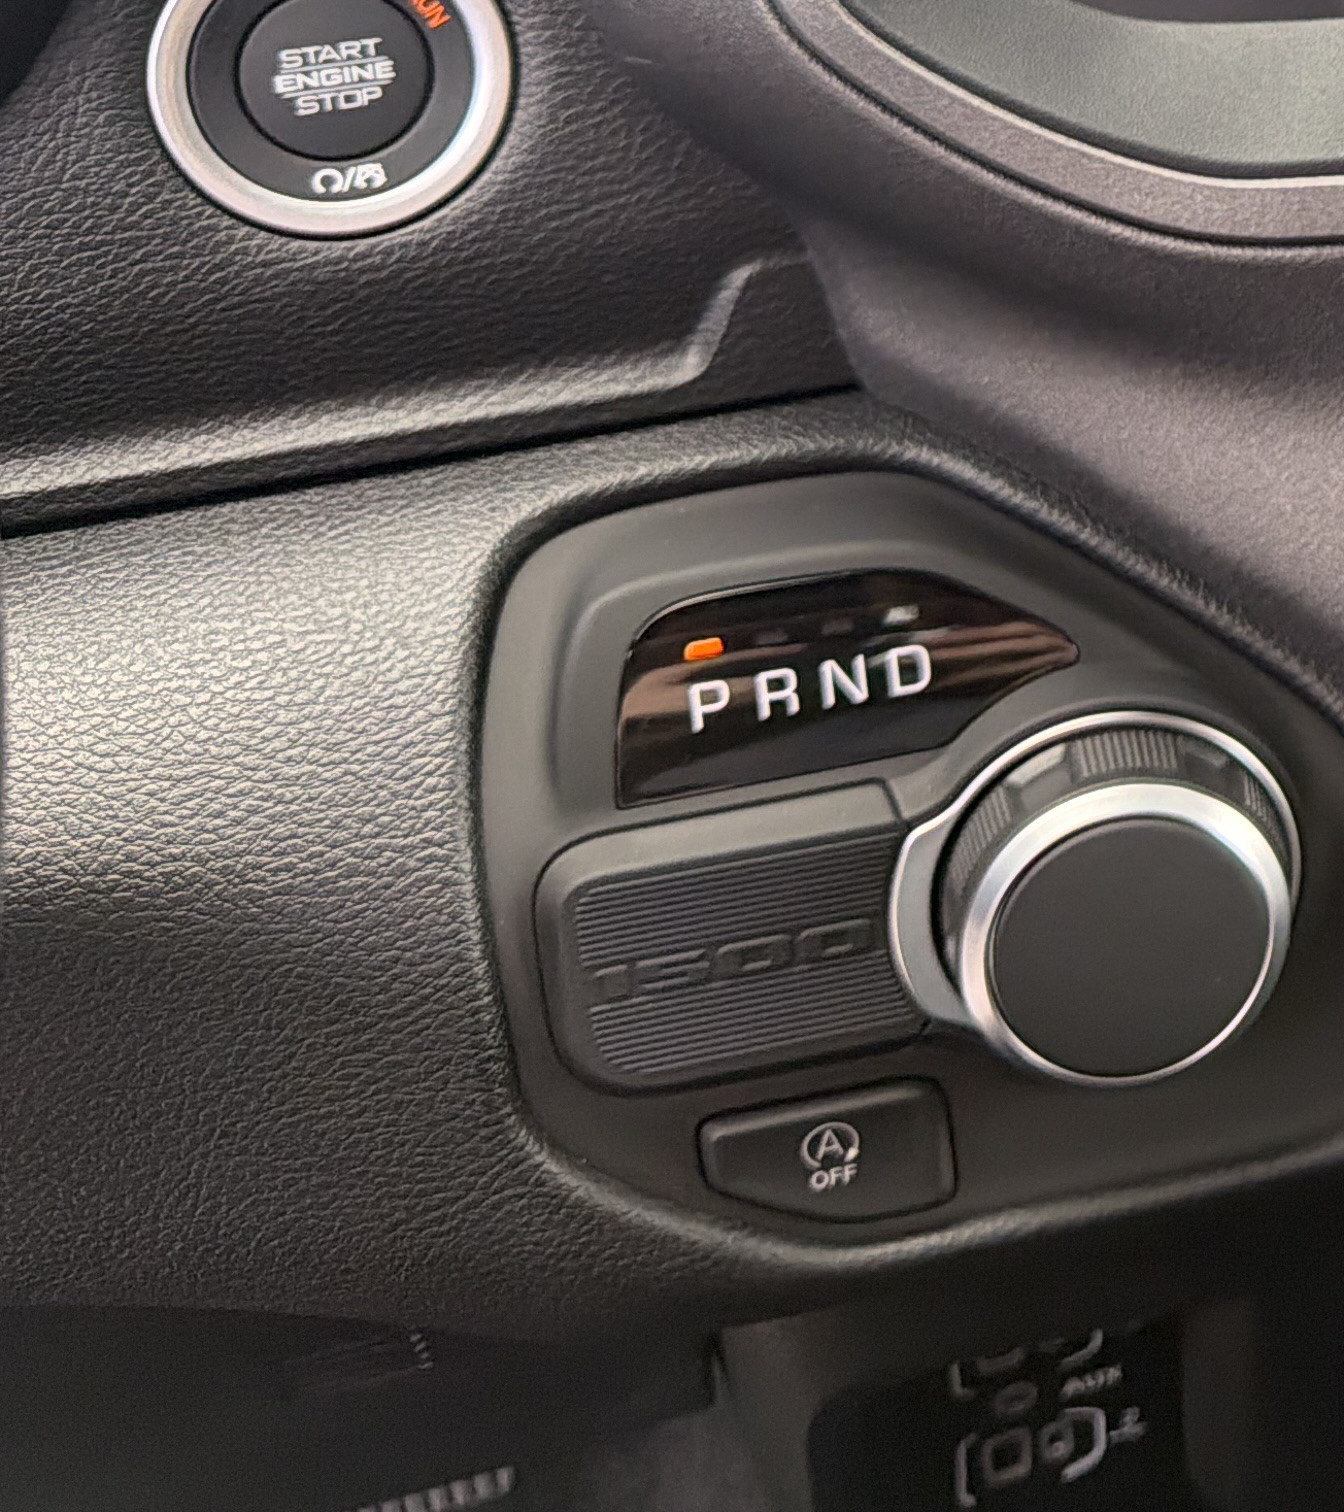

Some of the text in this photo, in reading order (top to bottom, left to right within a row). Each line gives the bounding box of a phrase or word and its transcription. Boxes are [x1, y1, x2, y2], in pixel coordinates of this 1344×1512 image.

[278, 37, 384, 69] START
[272, 60, 397, 95] ENGINE
[294, 86, 384, 117] STOP
[809, 1162, 858, 1194] OFF
